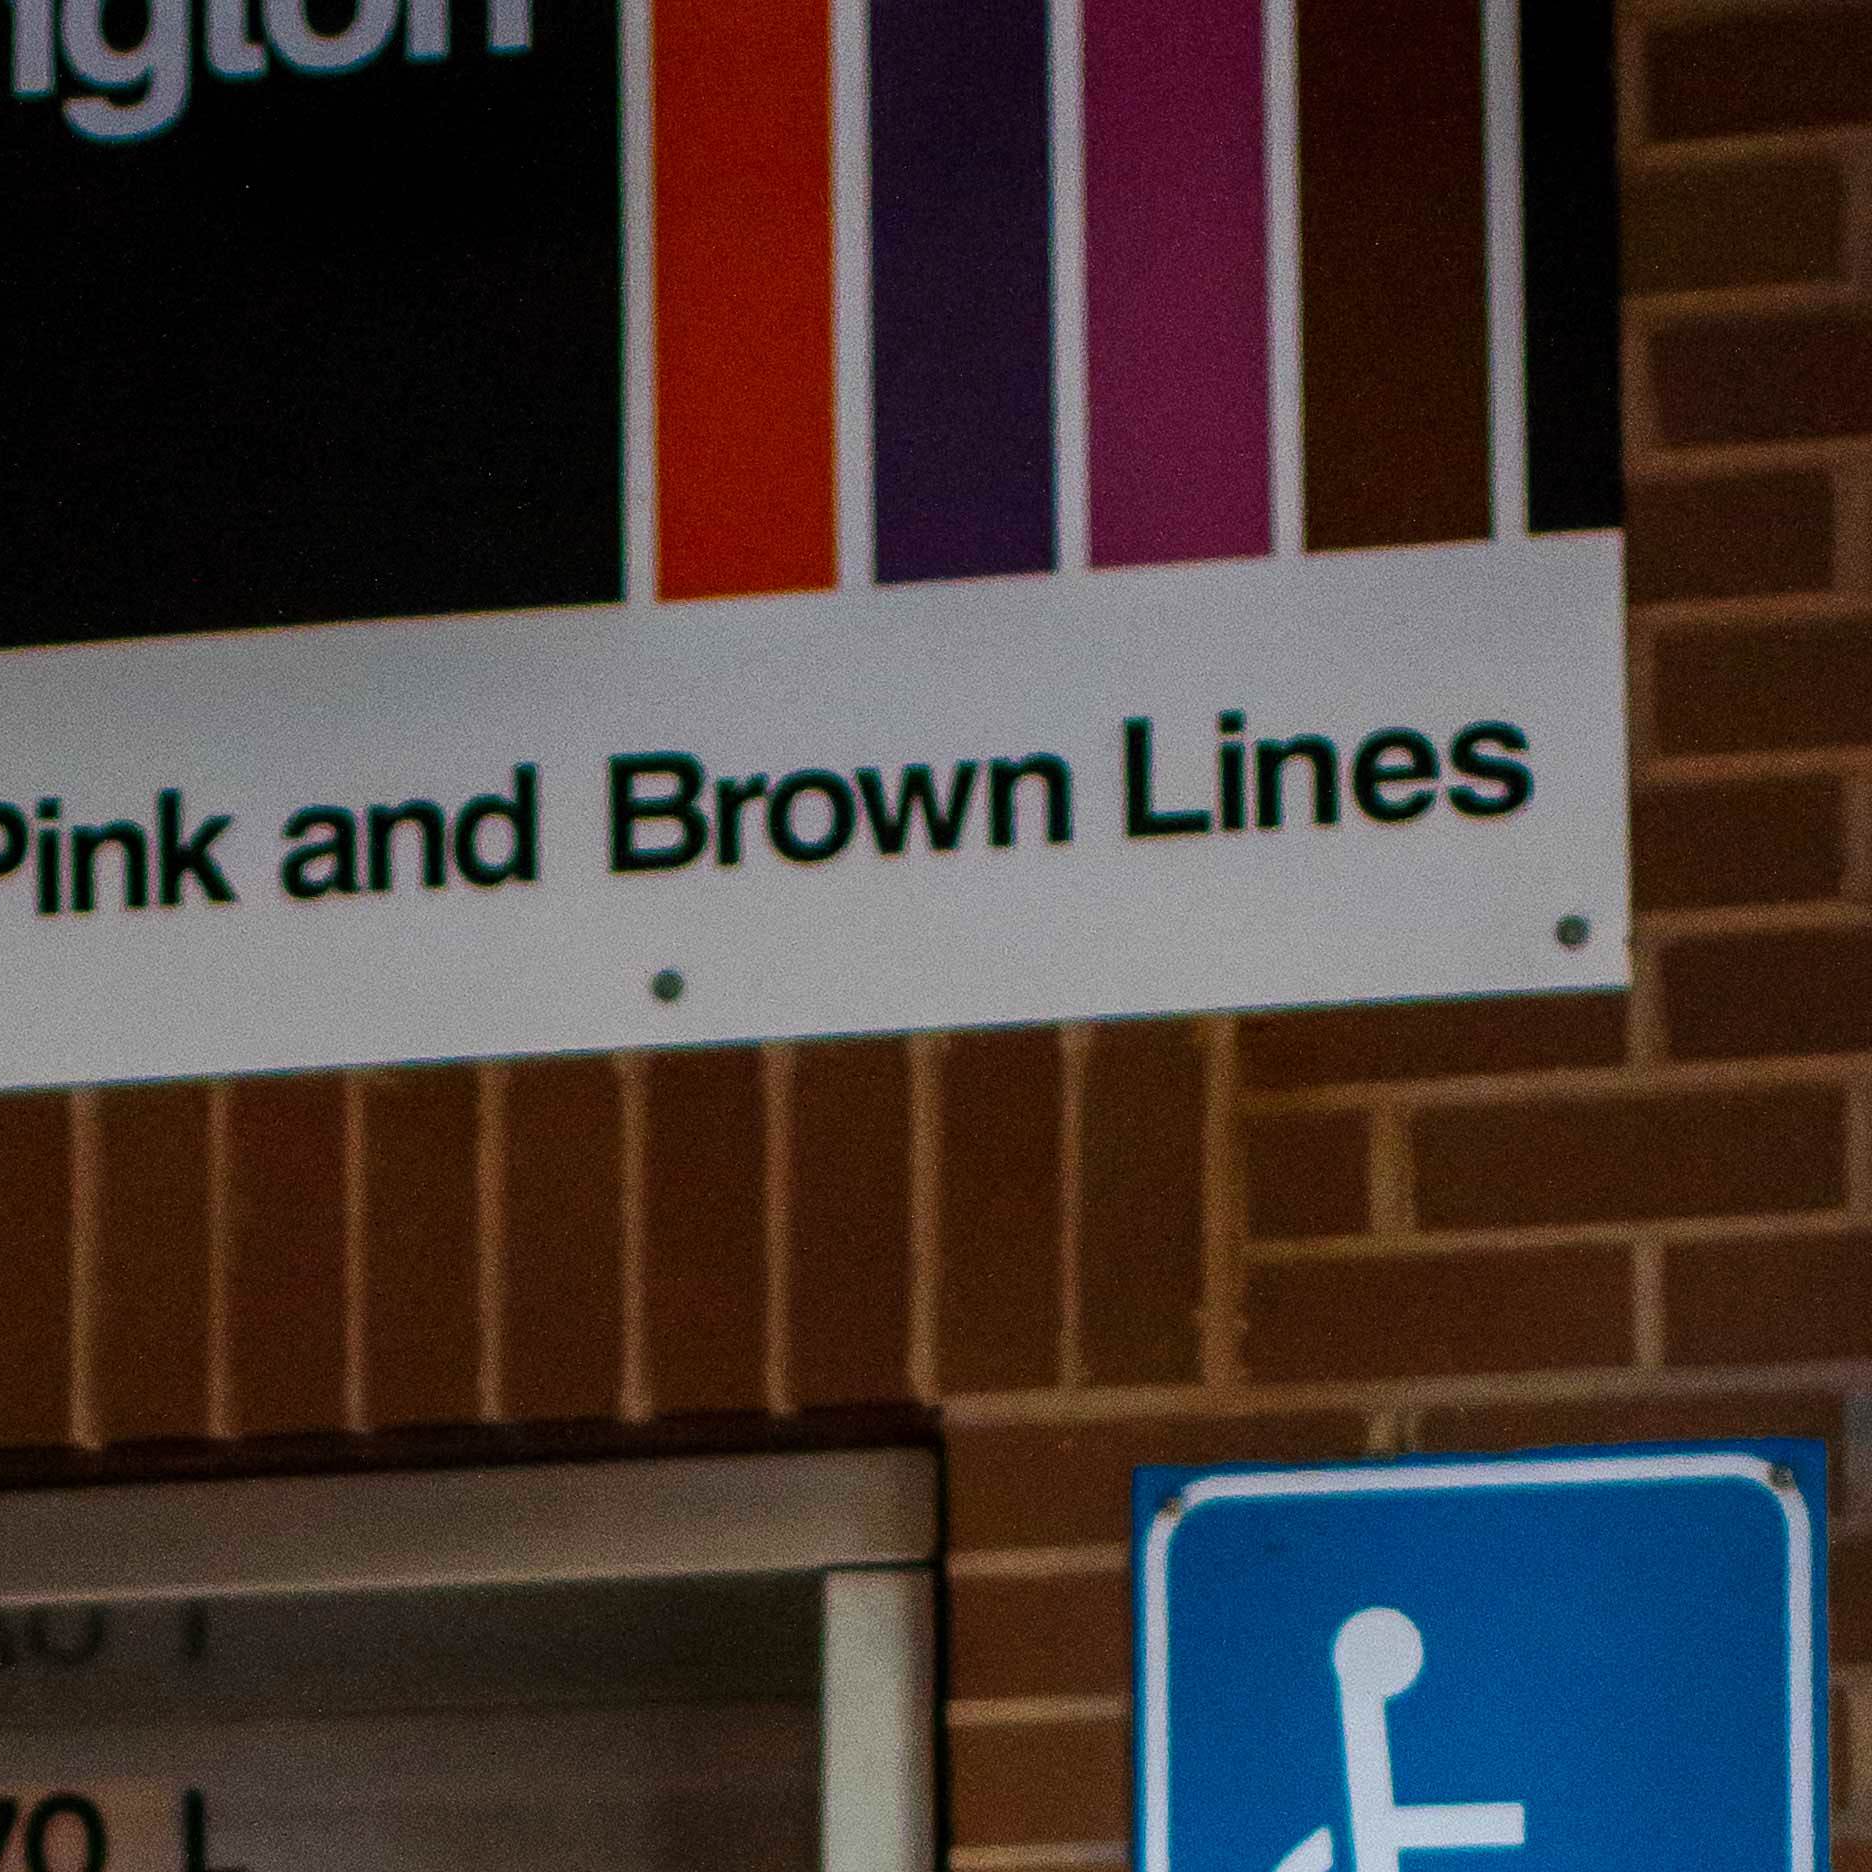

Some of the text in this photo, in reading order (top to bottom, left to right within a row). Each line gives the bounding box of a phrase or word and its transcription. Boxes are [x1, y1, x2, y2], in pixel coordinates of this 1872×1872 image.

[279, 762, 540, 902] and
[607, 750, 1074, 875] Brown
[1122, 710, 1535, 840] Lines
